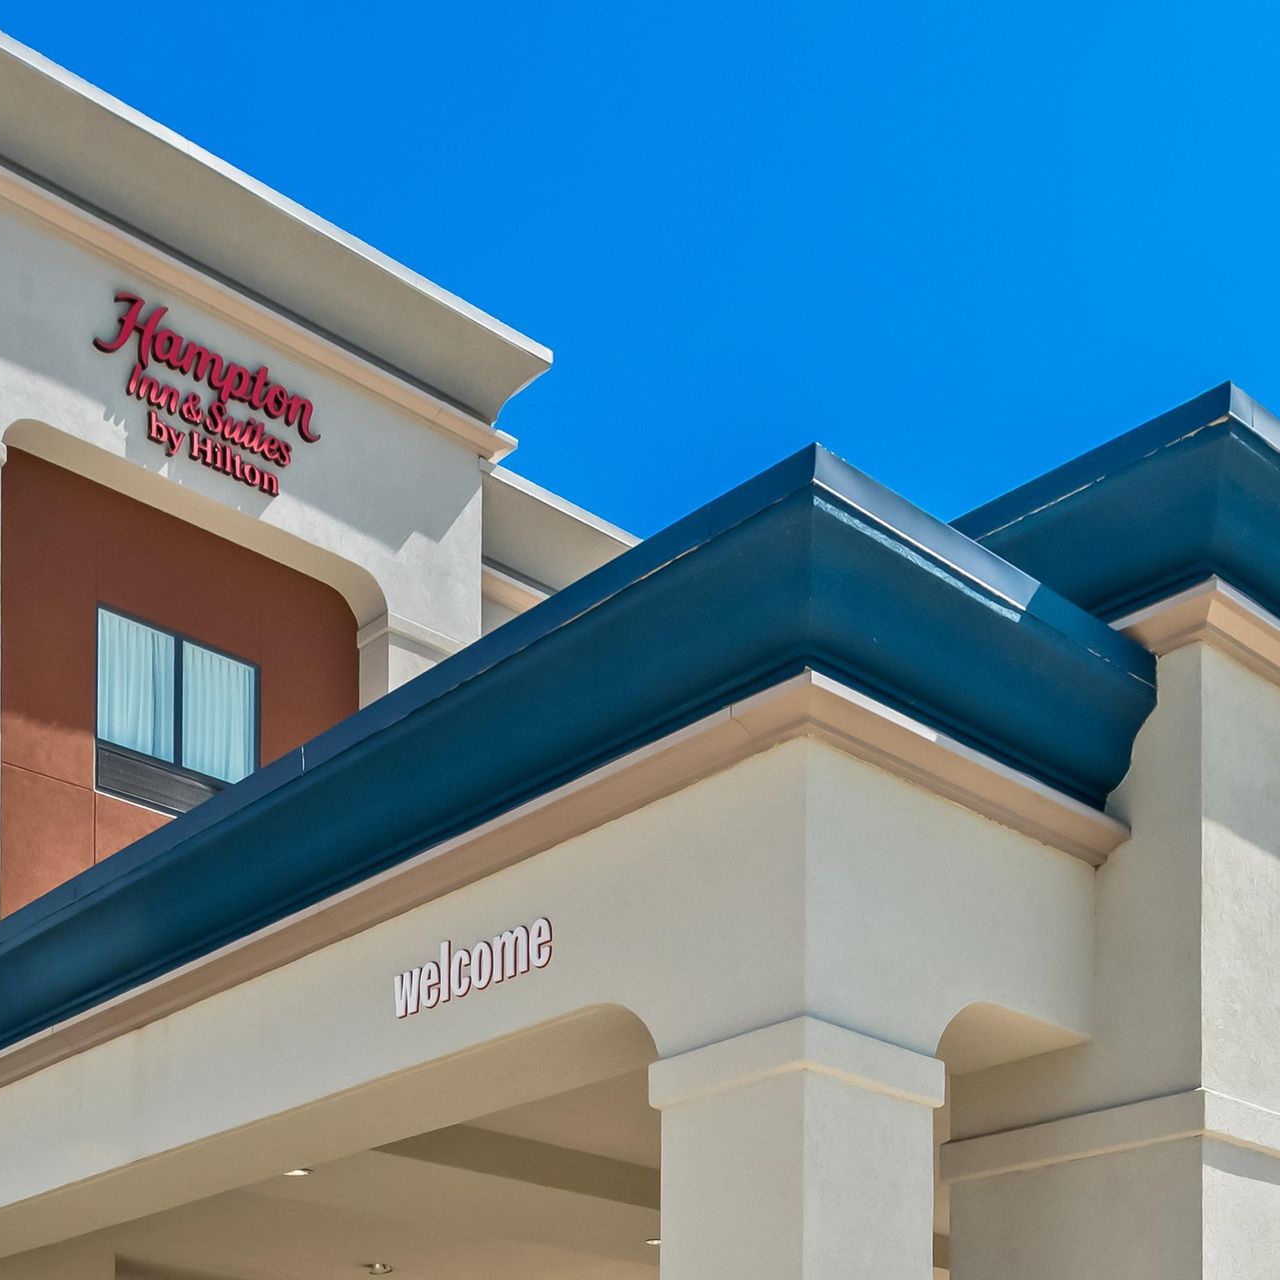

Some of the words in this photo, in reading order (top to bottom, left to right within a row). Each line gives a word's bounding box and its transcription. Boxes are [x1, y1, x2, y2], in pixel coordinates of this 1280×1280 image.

[93, 291, 320, 442] Hampton
[126, 363, 180, 415] Inn
[181, 392, 204, 425] &
[205, 401, 293, 467] Suites
[147, 410, 186, 456] by
[189, 430, 280, 496] Hilton
[394, 917, 553, 1019] welcome
